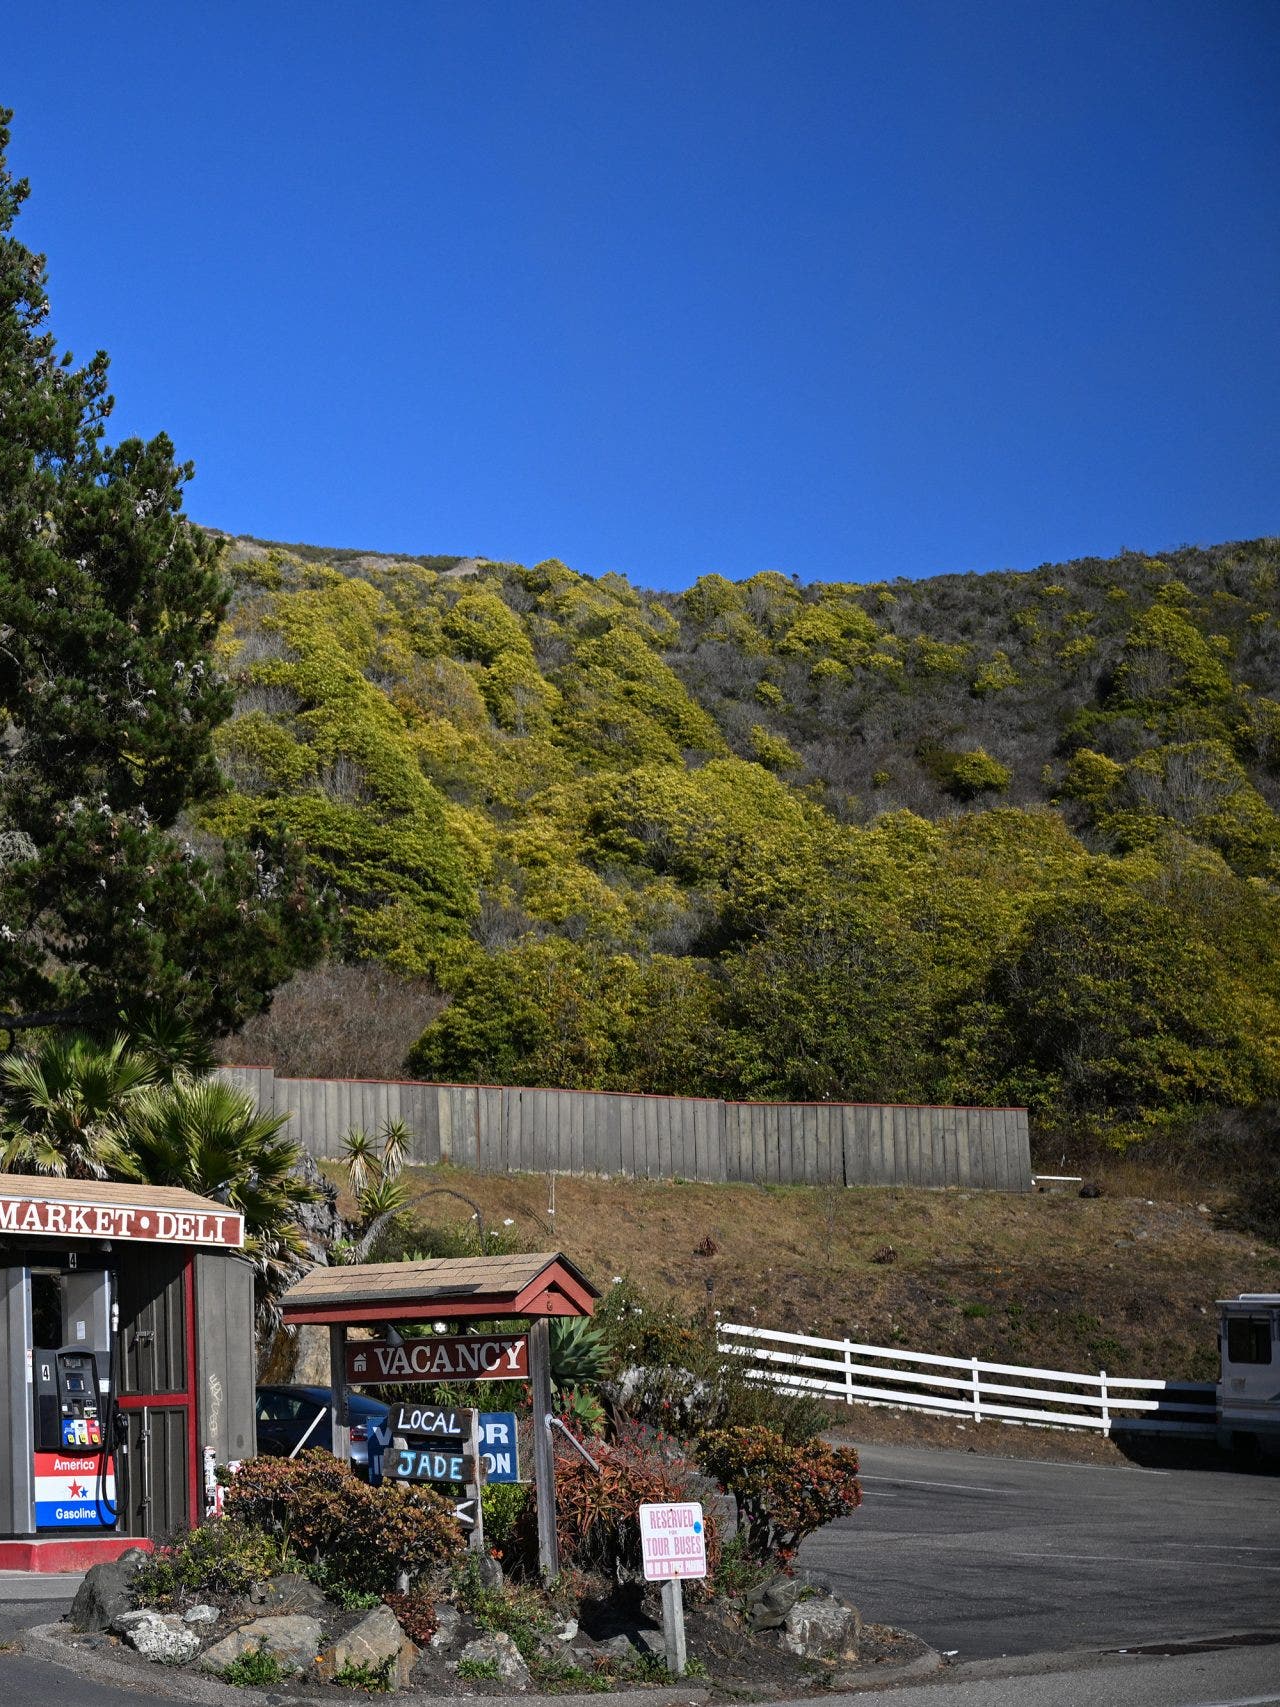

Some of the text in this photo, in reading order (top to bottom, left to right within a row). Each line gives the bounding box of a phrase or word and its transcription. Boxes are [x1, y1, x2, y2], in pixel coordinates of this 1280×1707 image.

[155, 1211, 227, 1243] DELI
[374, 1340, 525, 1375] VACANCY
[397, 1408, 461, 1434] LOCAL
[54, 1459, 95, 1471] Americo
[397, 1451, 463, 1480] JADE
[55, 1507, 97, 1520] Gasoline
[650, 1509, 694, 1530] RESERVED
[646, 1535, 702, 1557] TOUR BUSES
